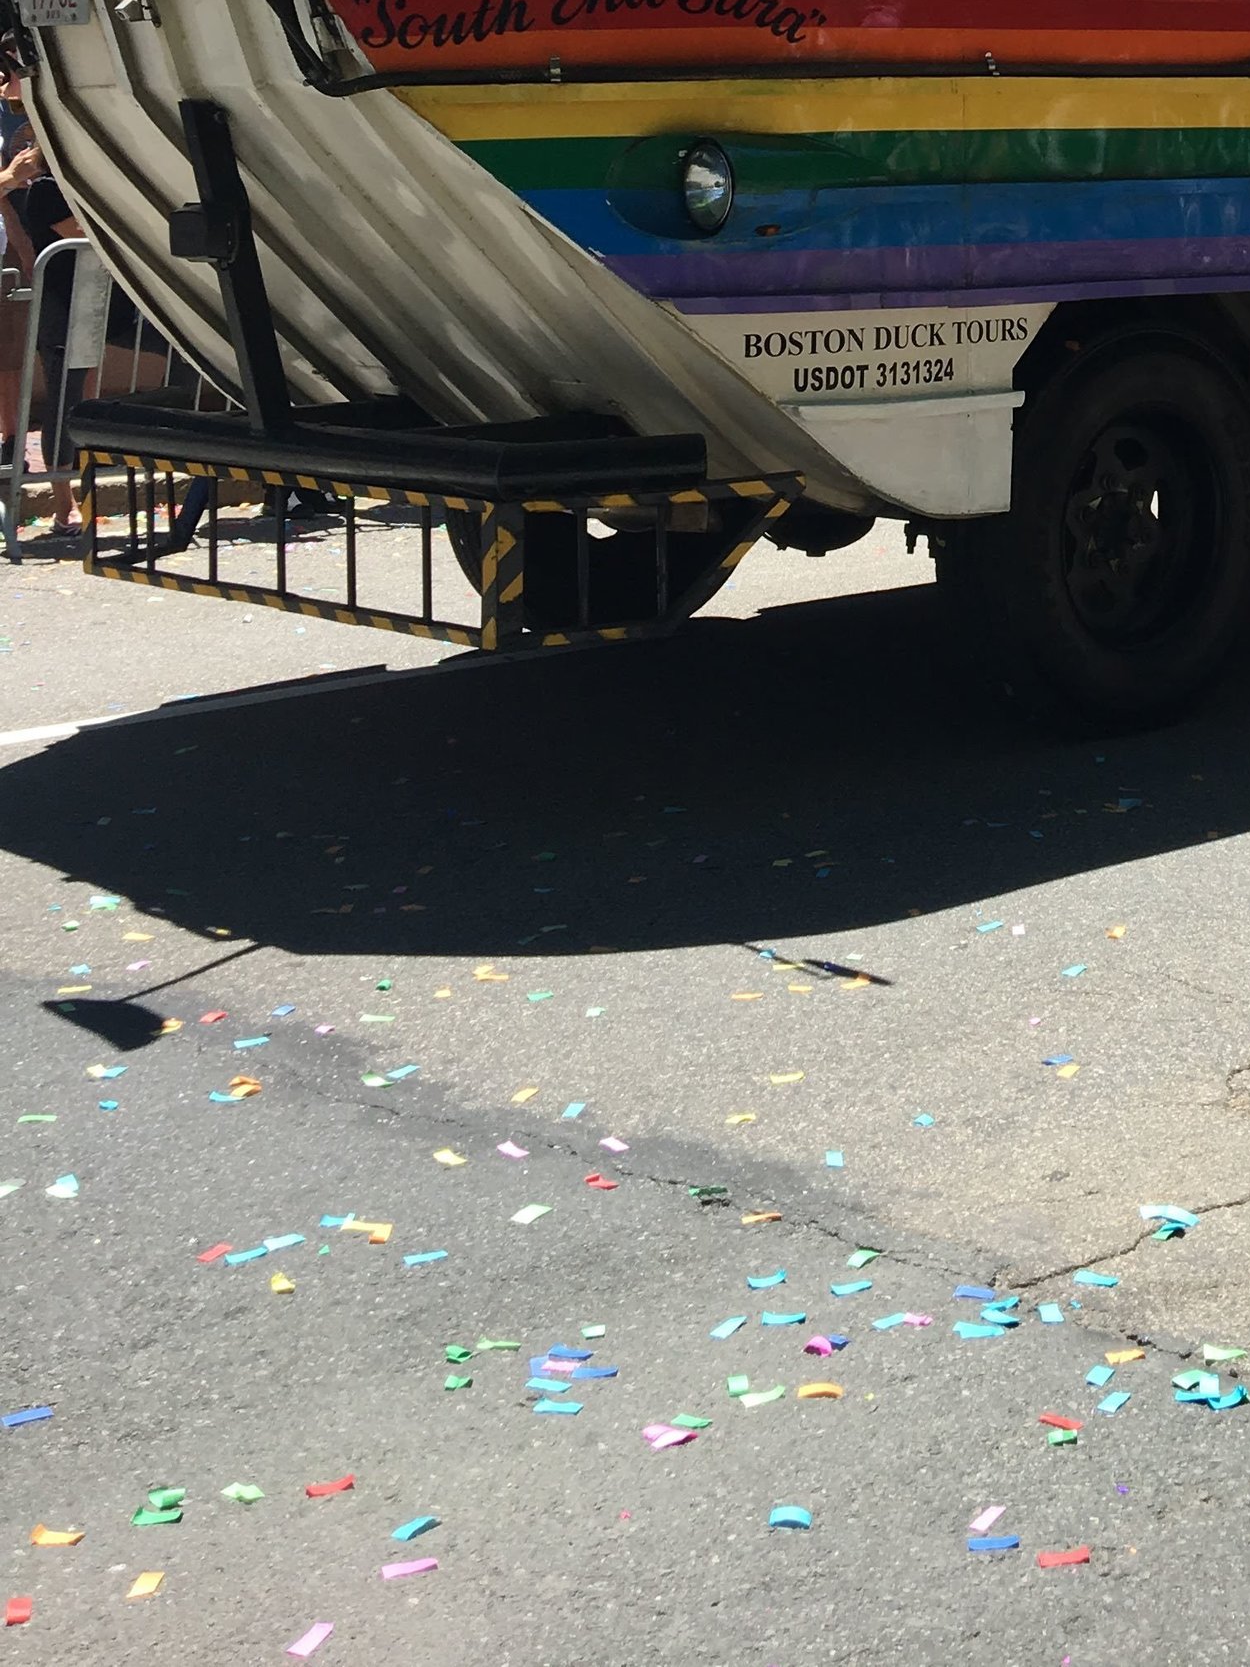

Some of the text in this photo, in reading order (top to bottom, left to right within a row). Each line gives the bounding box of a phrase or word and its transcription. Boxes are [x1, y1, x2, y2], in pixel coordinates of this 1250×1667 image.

[744, 317, 1029, 358] BOSTON DUCK TOURS
[794, 358, 954, 392] USDOT 3131324
